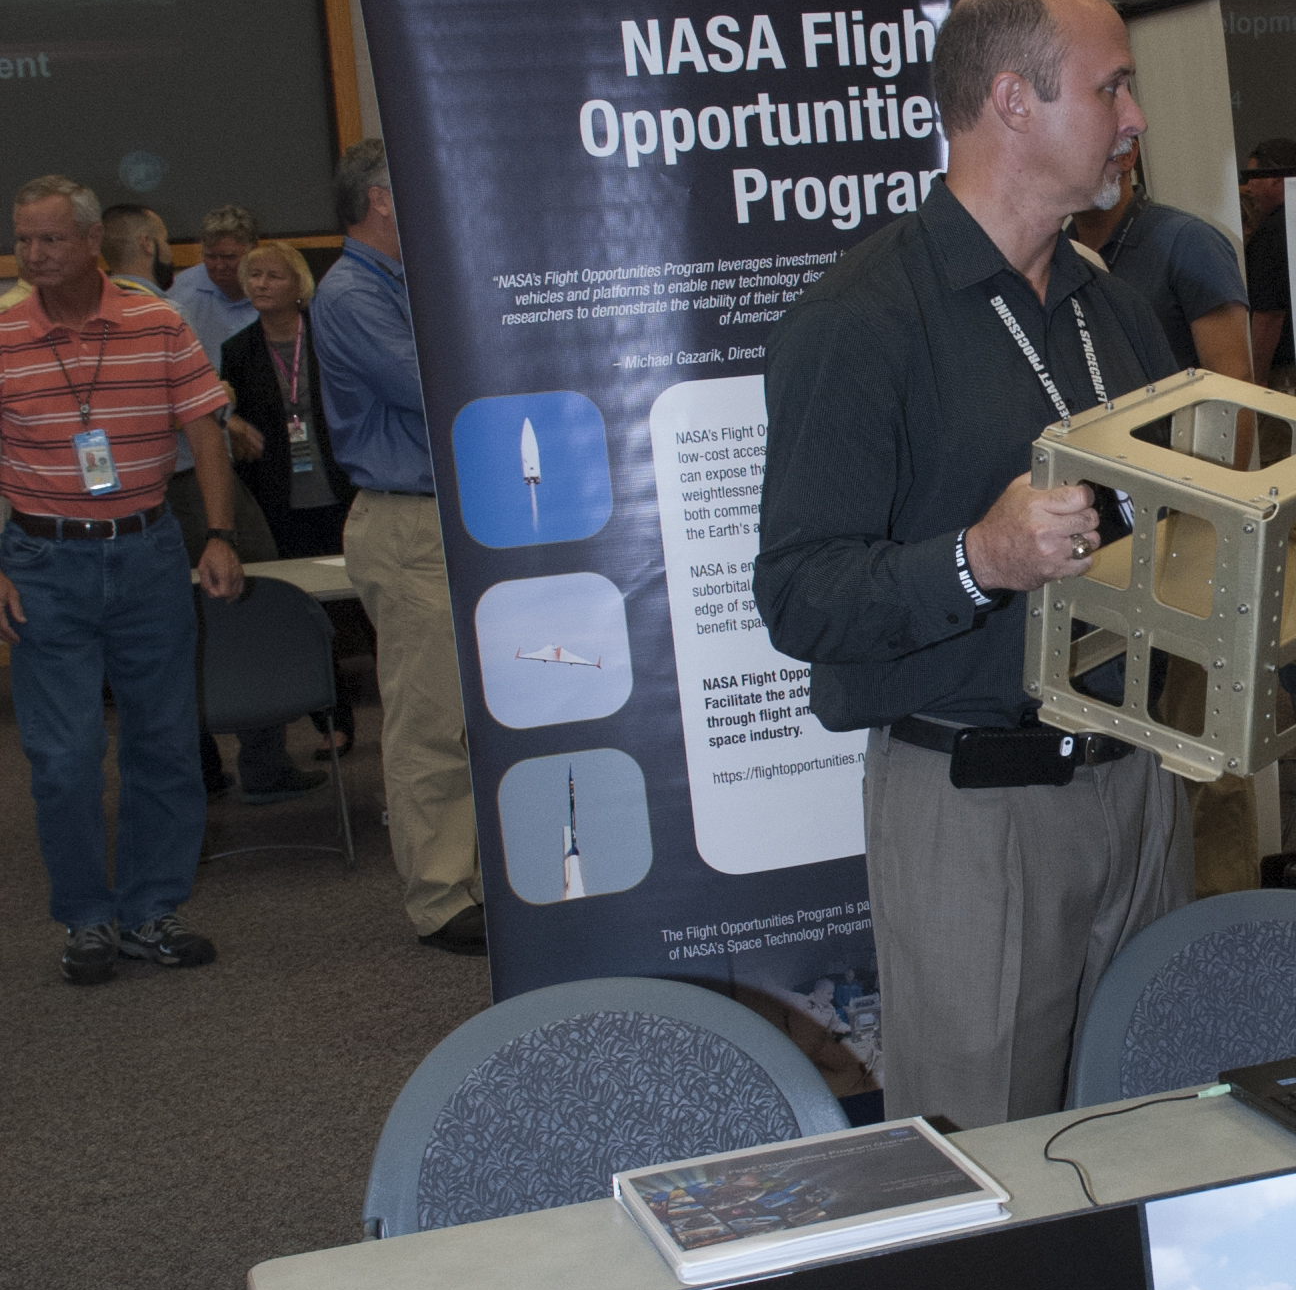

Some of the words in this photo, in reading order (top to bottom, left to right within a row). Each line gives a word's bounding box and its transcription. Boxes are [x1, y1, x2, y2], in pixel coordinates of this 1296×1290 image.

[621, 14, 787, 76] NASA
[801, 8, 935, 77] Fligh
[544, 269, 578, 287] Flight
[581, 264, 661, 284] Opportunities
[664, 261, 714, 277] Program
[717, 257, 772, 272] leverages
[775, 250, 837, 267] investment
[515, 290, 563, 305] vehicles
[566, 287, 590, 301] and
[592, 284, 649, 302] platforms
[653, 282, 664, 294] to
[667, 278, 707, 293] enable
[710, 278, 736, 290] new
[738, 272, 800, 288] technology
[501, 308, 573, 324] researchers
[576, 306, 588, 319] to
[591, 300, 667, 317] demonstrate
[670, 298, 689, 311] the
[692, 294, 736, 309] viability
[738, 291, 751, 305] of
[753, 290, 780, 304] their
[718, 311, 731, 325] of
[990, 295, 1045, 372] PROCESSING
[624, 352, 673, 369] Michael
[676, 348, 724, 364] Gazarik,
[1080, 329, 1108, 402] SPACECRAFT
[675, 429, 718, 444] NASA's
[721, 425, 754, 441] Flight
[677, 447, 729, 463] low-cost
[733, 445, 766, 459] acces
[680, 471, 701, 482] can
[705, 466, 746, 481] expose
[682, 483, 764, 504] weightlessnes
[683, 507, 710, 521] both
[714, 504, 761, 519] commer
[685, 527, 704, 540] the
[709, 522, 750, 538] Earth's
[690, 562, 724, 577] NASA
[727, 562, 737, 574] is
[692, 579, 751, 598] suborbital
[694, 602, 723, 617] edge
[727, 598, 738, 612] of
[696, 619, 736, 634] benefit
[740, 618, 767, 632] spac
[702, 675, 738, 690] NASA
[741, 670, 776, 686] Flight
[704, 692, 762, 709] Facilitate
[765, 689, 785, 701] the
[706, 711, 755, 728] through
[758, 706, 791, 722] flight
[795, 704, 814, 718] an
[708, 733, 746, 748] space
[749, 725, 802, 741] industry.
[713, 752, 865, 786] https://flightopportunities.n
[660, 929, 683, 942] The
[685, 923, 717, 940] Flight
[720, 913, 794, 936] Opportunities
[796, 905, 842, 922] Program
[844, 901, 854, 913] is
[668, 946, 679, 960] of
[683, 941, 724, 958] NASA's
[726, 938, 762, 954] Space
[763, 927, 824, 946] Technology
[826, 918, 871, 935] Program
